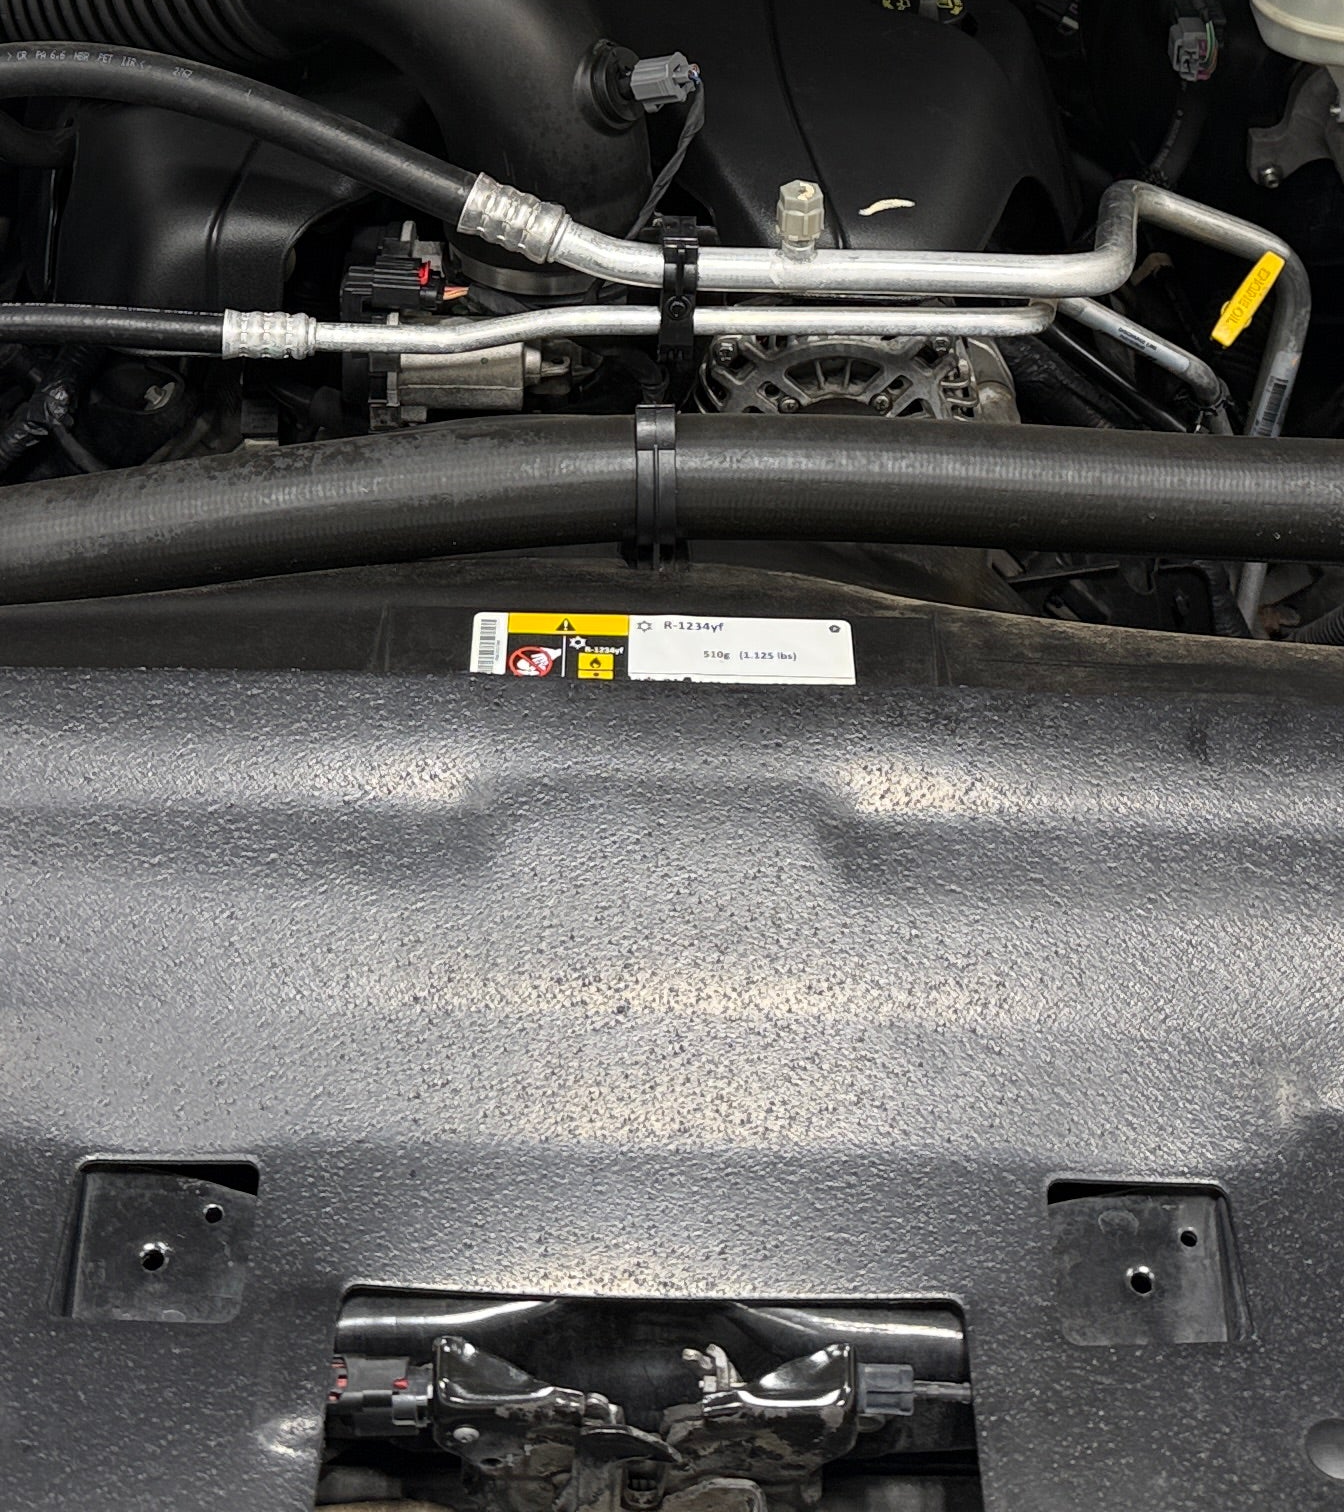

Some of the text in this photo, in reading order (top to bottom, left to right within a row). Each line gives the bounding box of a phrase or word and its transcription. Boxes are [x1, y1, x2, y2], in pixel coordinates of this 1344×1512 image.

[664, 621, 724, 632] R-1234yf
[584, 646, 625, 655] R-1234yf
[703, 650, 797, 661] 510g (1.125 lbs)
